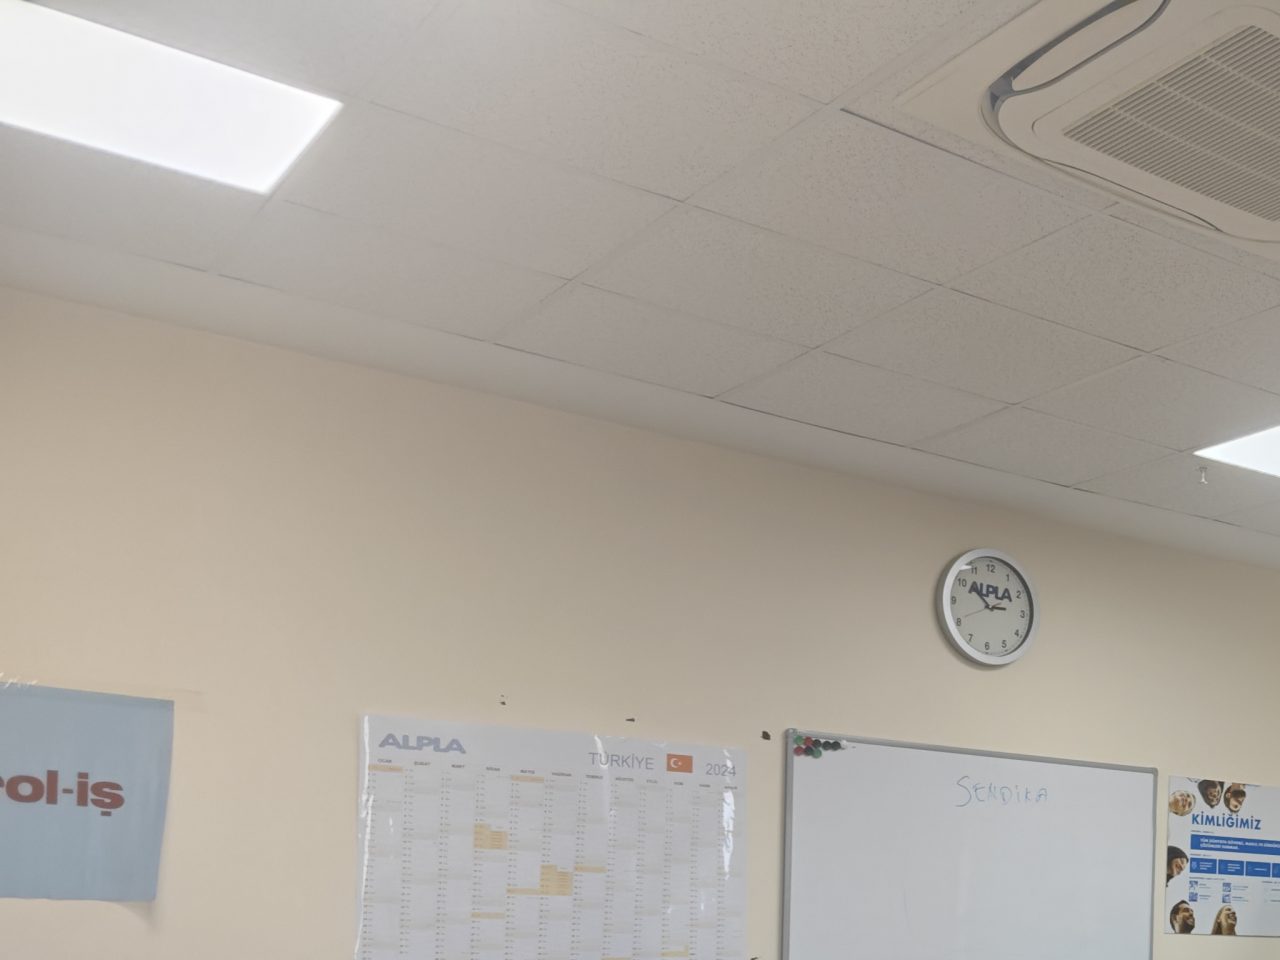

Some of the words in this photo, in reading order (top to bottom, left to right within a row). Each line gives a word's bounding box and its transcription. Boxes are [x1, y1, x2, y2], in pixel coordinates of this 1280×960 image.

[986, 564, 995, 573] 12
[958, 578, 967, 588] 10
[968, 581, 1012, 602] ALPLA
[379, 733, 466, 754] ALPLA
[588, 751, 655, 770] TÜRKİYE
[705, 763, 737, 777] 2024
[0, 770, 125, 816] ol-iş
[1191, 811, 1261, 830] KİMLİĞİMİZ
